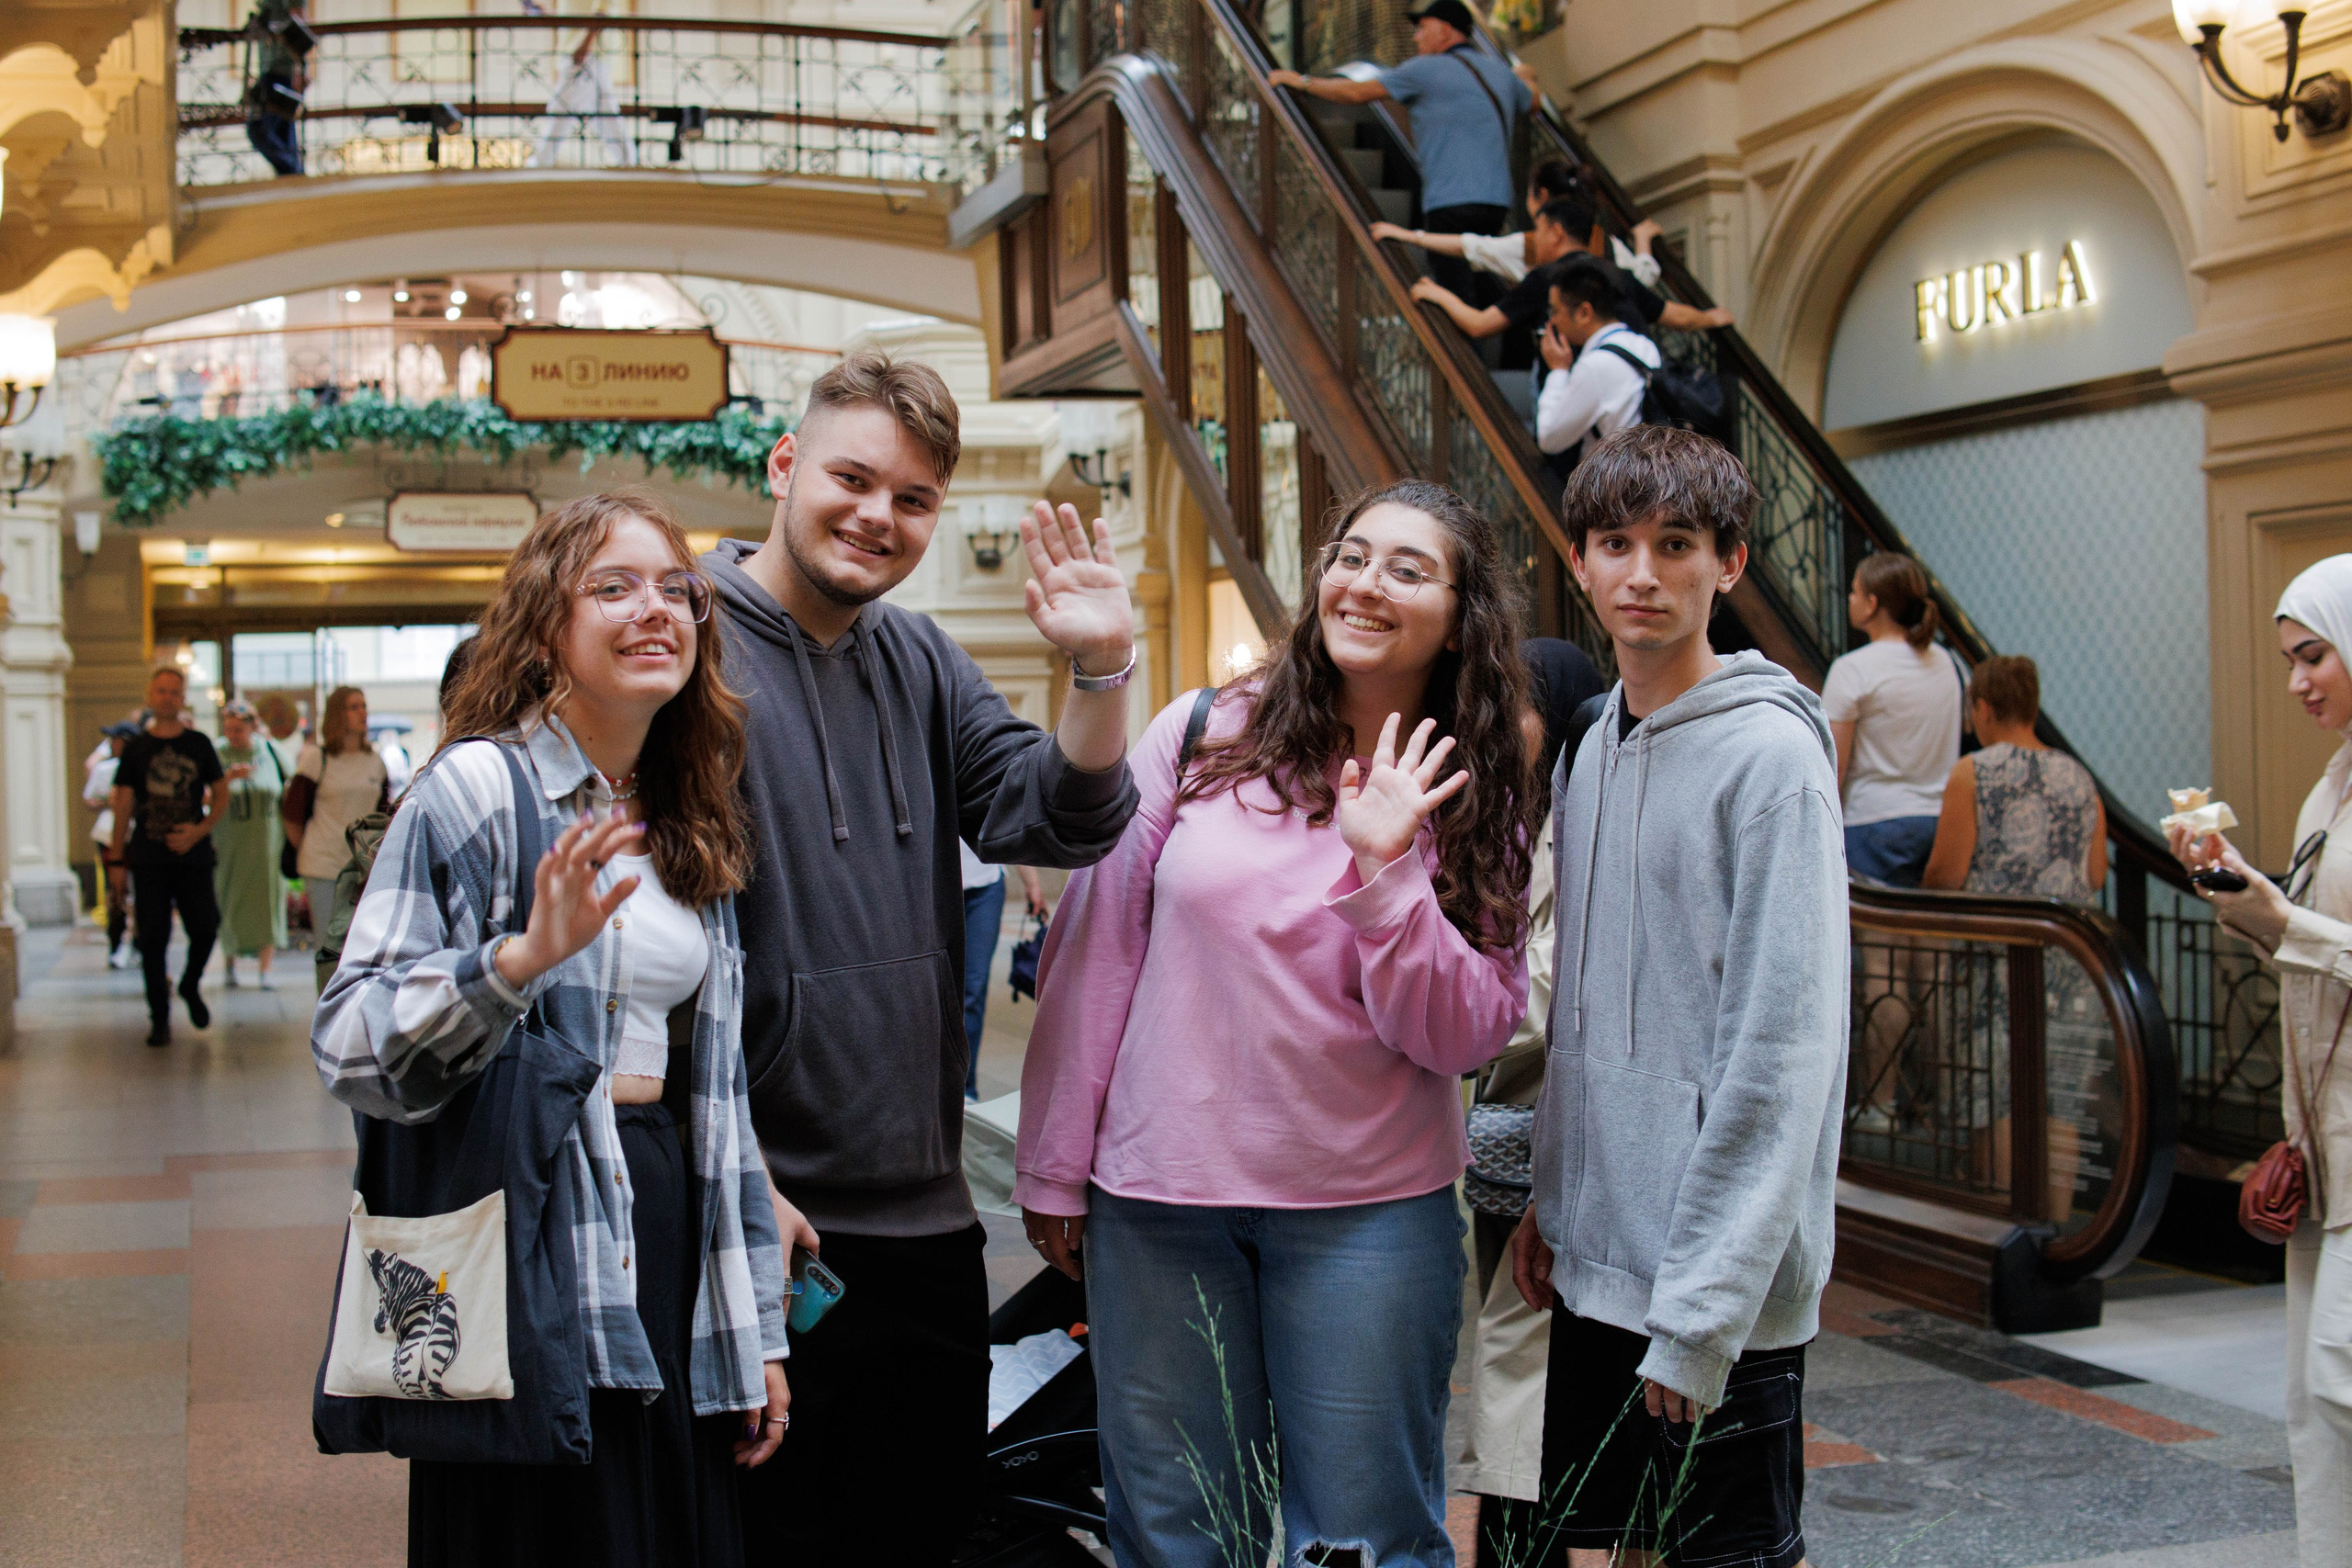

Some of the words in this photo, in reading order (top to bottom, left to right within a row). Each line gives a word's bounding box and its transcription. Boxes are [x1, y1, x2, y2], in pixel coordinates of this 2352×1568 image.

[1916, 240, 2097, 344] FURLA
[531, 362, 562, 381] НА
[603, 362, 689, 381] ЛИНИЮ
[1001, 1450, 1039, 1469] YOYO
